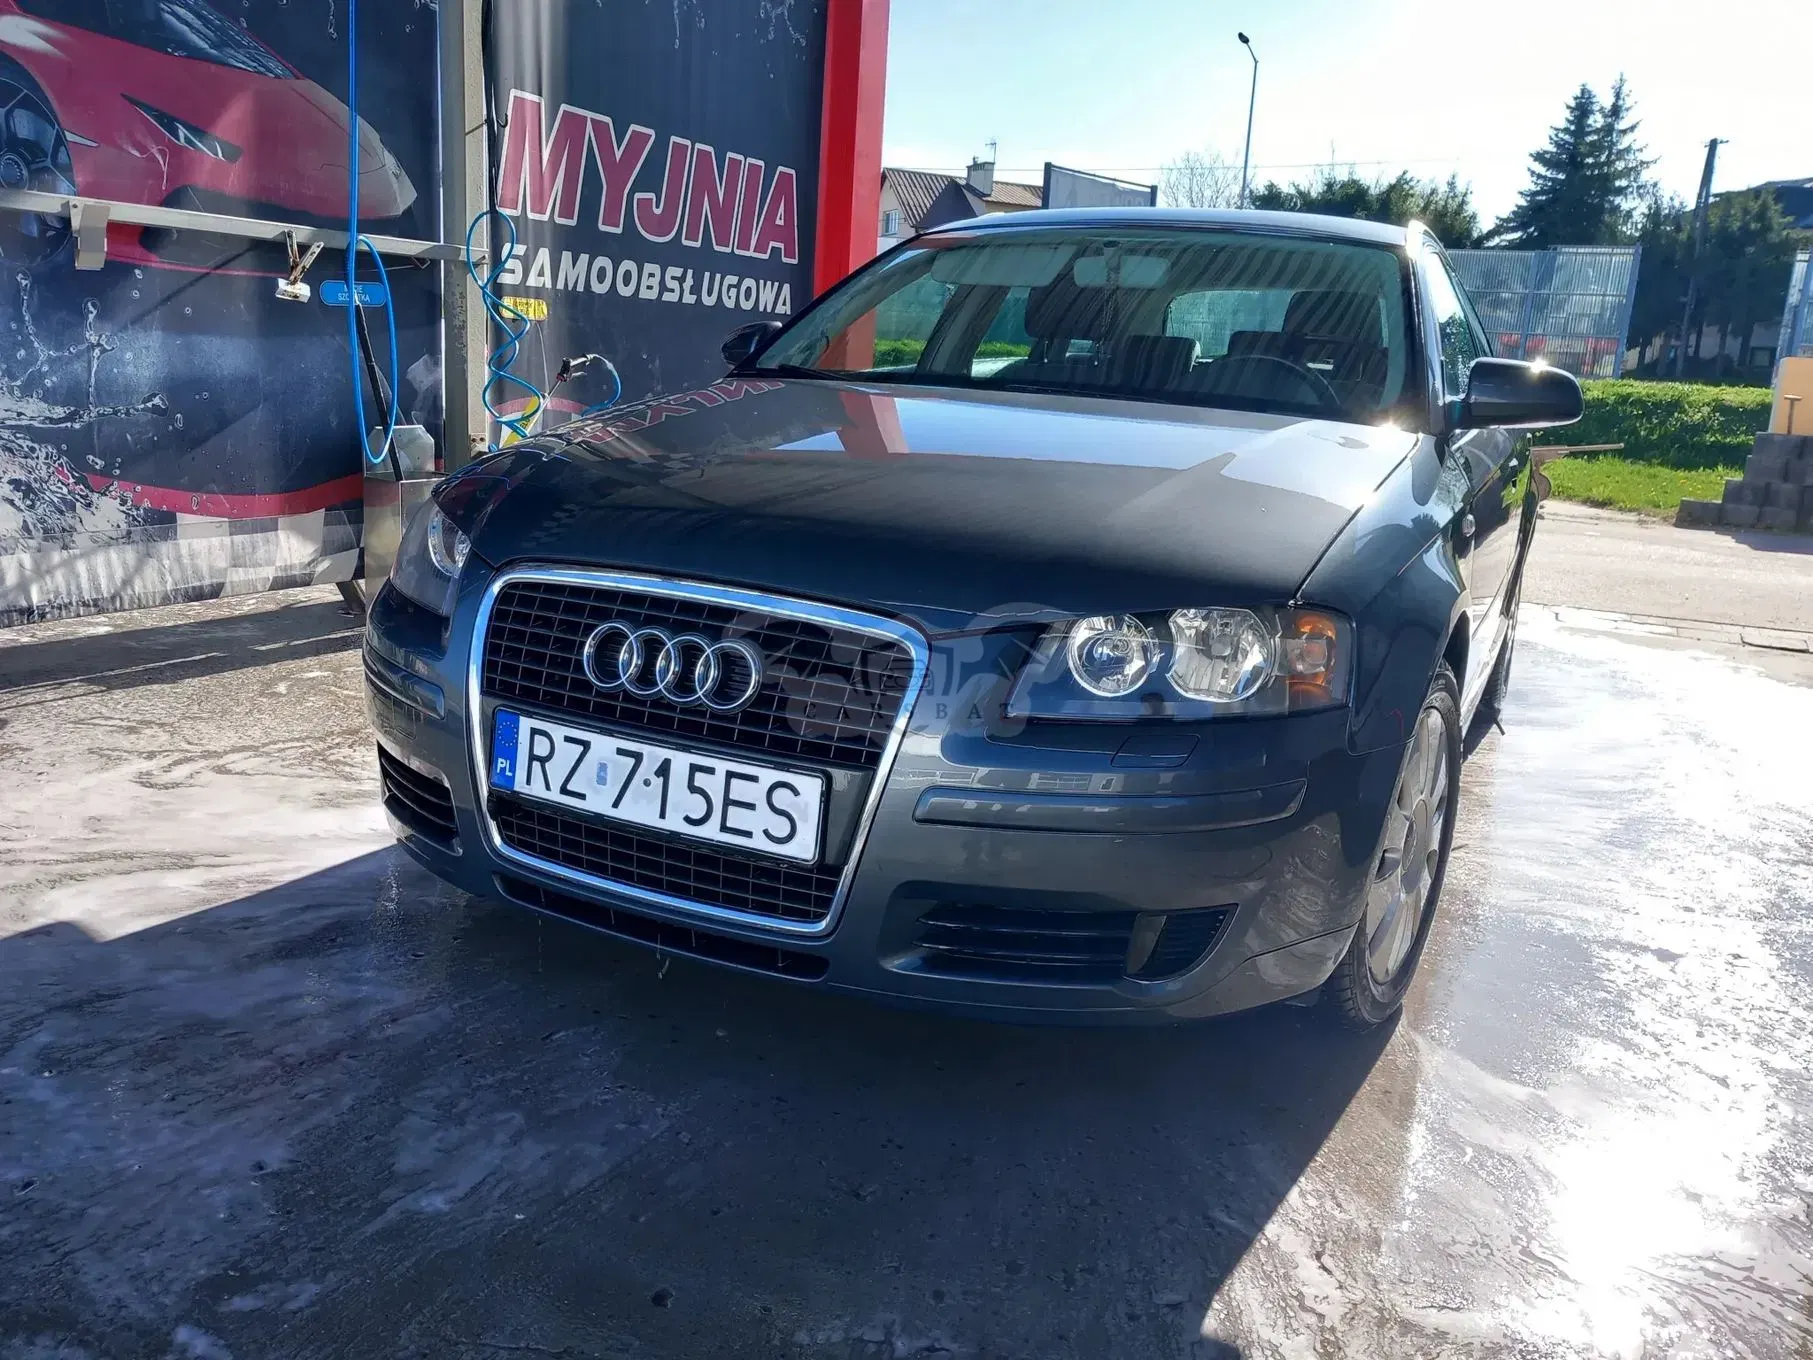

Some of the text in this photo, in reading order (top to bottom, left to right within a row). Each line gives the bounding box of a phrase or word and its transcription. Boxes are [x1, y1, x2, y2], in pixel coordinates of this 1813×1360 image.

[497, 89, 799, 265] MYJNIA
[497, 243, 792, 315] SAMOOBSŁUGOWA
[497, 758, 513, 777] PL
[525, 726, 802, 845] RZ 715ES
